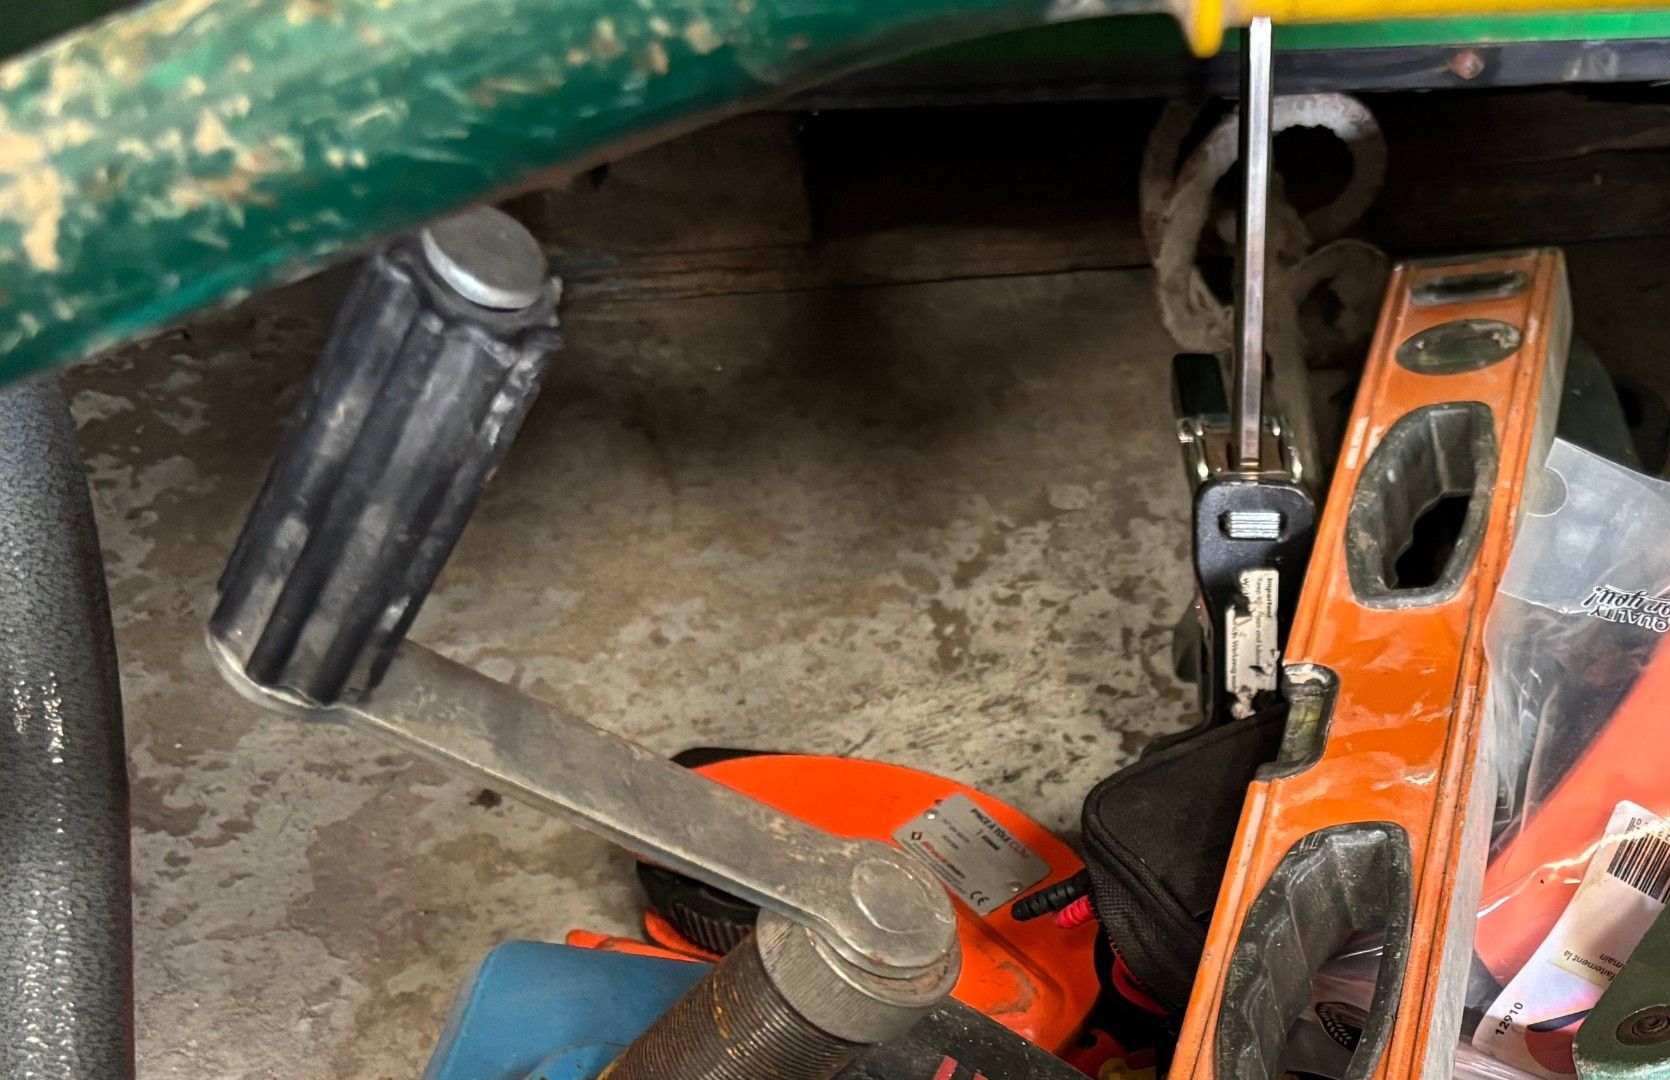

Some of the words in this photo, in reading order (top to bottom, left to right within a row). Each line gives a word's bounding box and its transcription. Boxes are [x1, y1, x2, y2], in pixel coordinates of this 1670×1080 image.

[1583, 586, 1650, 609] you!
[1588, 604, 1670, 632] QUALITY
[1494, 999, 1523, 1038] 12910
